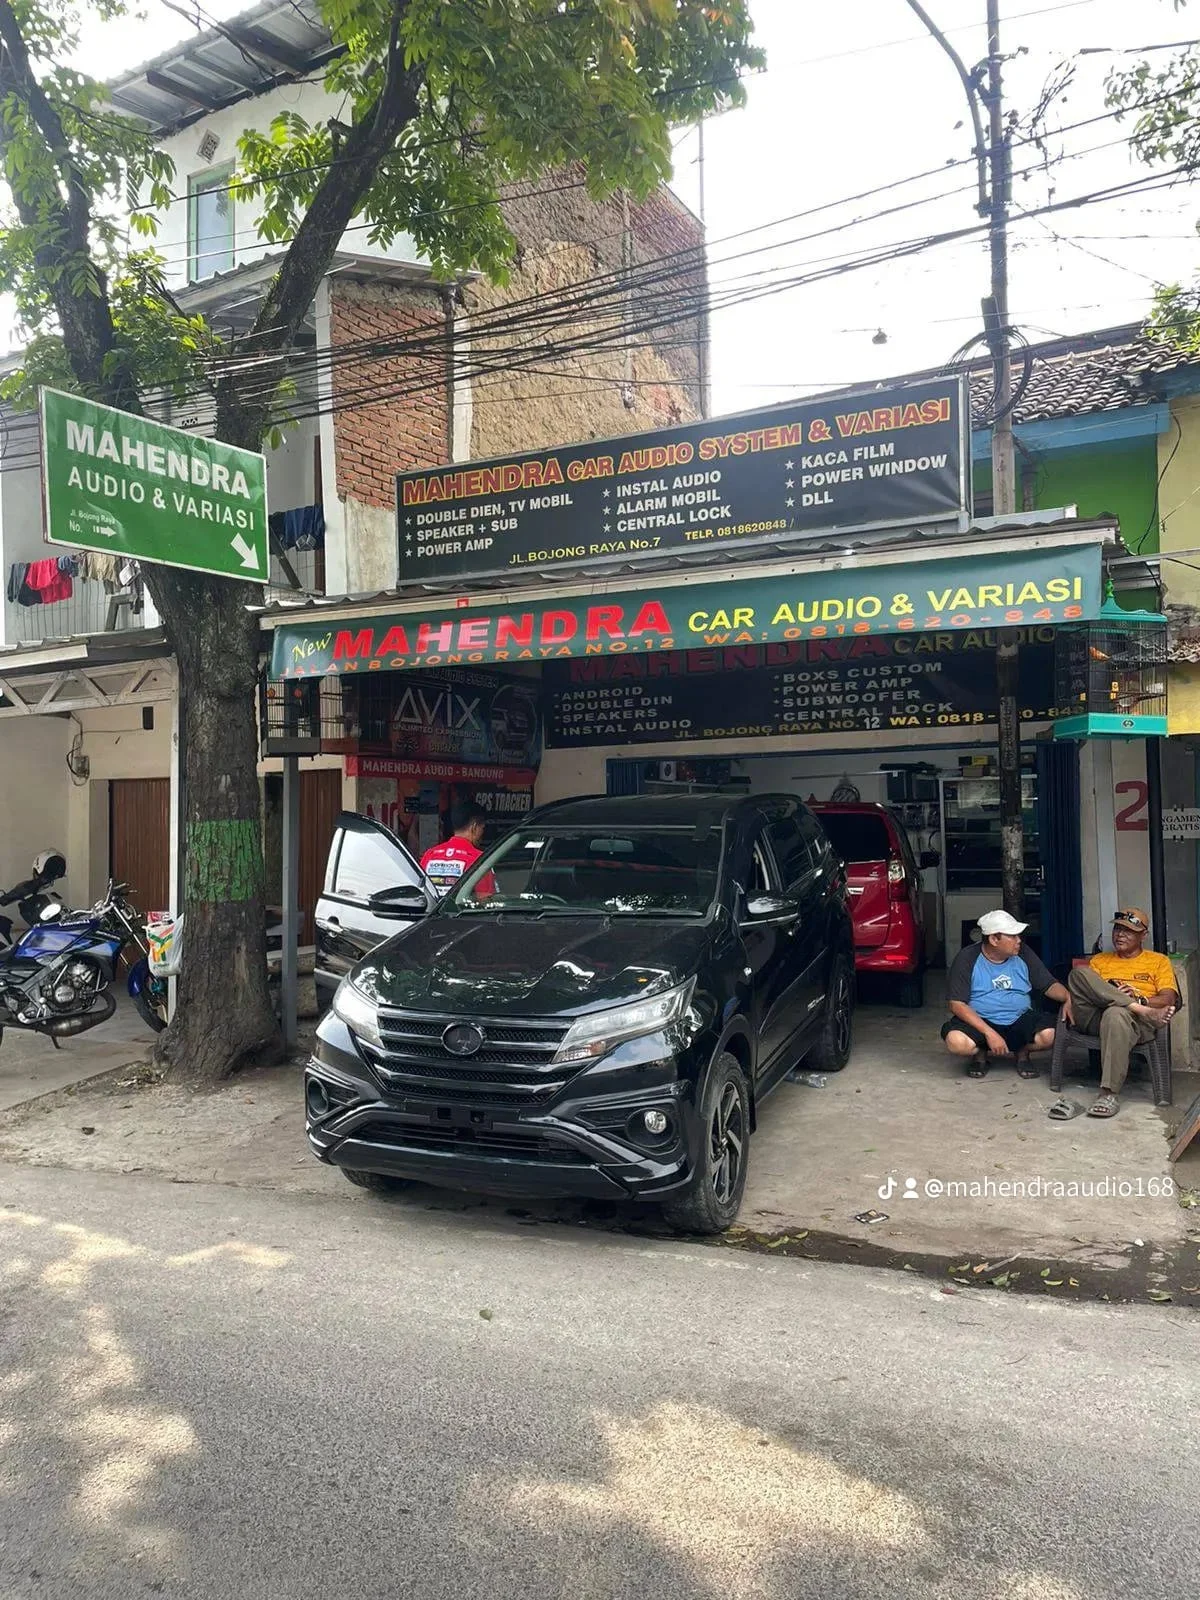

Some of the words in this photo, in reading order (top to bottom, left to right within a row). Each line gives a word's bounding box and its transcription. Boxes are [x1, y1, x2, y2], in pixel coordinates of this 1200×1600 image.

[66, 419, 251, 500] MAHENDRA
[403, 458, 564, 506] MAHENDRA
[566, 456, 614, 481] CAR
[618, 442, 694, 474] AUDIO
[699, 423, 801, 460] SYSTEM
[808, 419, 832, 442] &
[836, 398, 950, 438] VARIASI
[801, 450, 848, 470] KACA
[853, 442, 895, 461] FILM
[801, 466, 864, 489] POWER
[869, 454, 948, 478] WINDOW
[616, 479, 668, 498] INSTAL
[672, 470, 722, 490] AUDIO
[68, 466, 145, 504] AUDIO
[153, 488, 166, 510] &
[173, 492, 254, 530] VARIASI
[416, 508, 467, 526] DOUBLE
[470, 504, 506, 518] DIEN,
[508, 500, 526, 514] TV
[530, 493, 573, 510] MOBIL
[616, 498, 667, 516] ALARM
[672, 489, 720, 507] MOBIL
[802, 491, 834, 506] DLL
[70, 520, 83, 533] No.
[616, 512, 686, 532] CENTRAL
[690, 504, 732, 522] LOCK
[416, 524, 474, 542] SPEAKER
[478, 524, 487, 534] +
[490, 518, 518, 532] SUB
[685, 529, 714, 541] TELP.
[718, 519, 786, 536] 0818620848
[417, 542, 462, 558] POWER
[465, 538, 494, 552] AMP
[509, 545, 586, 565] JL.BOJONG
[589, 540, 626, 554] RAYA
[630, 536, 662, 550] No.7
[292, 632, 332, 662] New
[333, 600, 672, 660] MAHENDRA
[688, 607, 755, 632] CAR
[772, 596, 882, 624] AUDIO
[889, 593, 914, 616] &
[927, 576, 1082, 614] VARIASI
[280, 662, 358, 678] JALAN
[368, 652, 482, 670] BOJONG
[495, 645, 572, 660] RAYA
[586, 638, 674, 654] NO.12
[570, 637, 889, 683] MAHENDRA
[894, 632, 954, 654] CAR
[783, 670, 839, 683] BOXS
[848, 662, 942, 678] CUSTOM
[562, 686, 643, 700] ANDROID
[783, 681, 857, 696] POWER
[866, 677, 912, 689] AMP
[562, 698, 634, 712] DOUBLE
[641, 696, 673, 707] DIN
[783, 690, 921, 708] SUBWOOFER
[562, 708, 658, 724] SPEAKERS
[783, 707, 883, 721] CENTRAL
[892, 703, 953, 714] LOCK
[562, 724, 627, 736] INSTAL
[633, 719, 692, 731] AUDIO
[703, 725, 772, 737] BOJONG
[779, 722, 823, 733] RAYA
[864, 716, 880, 729] 12
[362, 760, 421, 776] MAHENDRA
[424, 764, 453, 776] AUDIO
[462, 768, 504, 779] BANDUNG
[475, 792, 493, 812] GPS
[494, 793, 531, 812] TRACKER
[1115, 780, 1148, 831] 2
